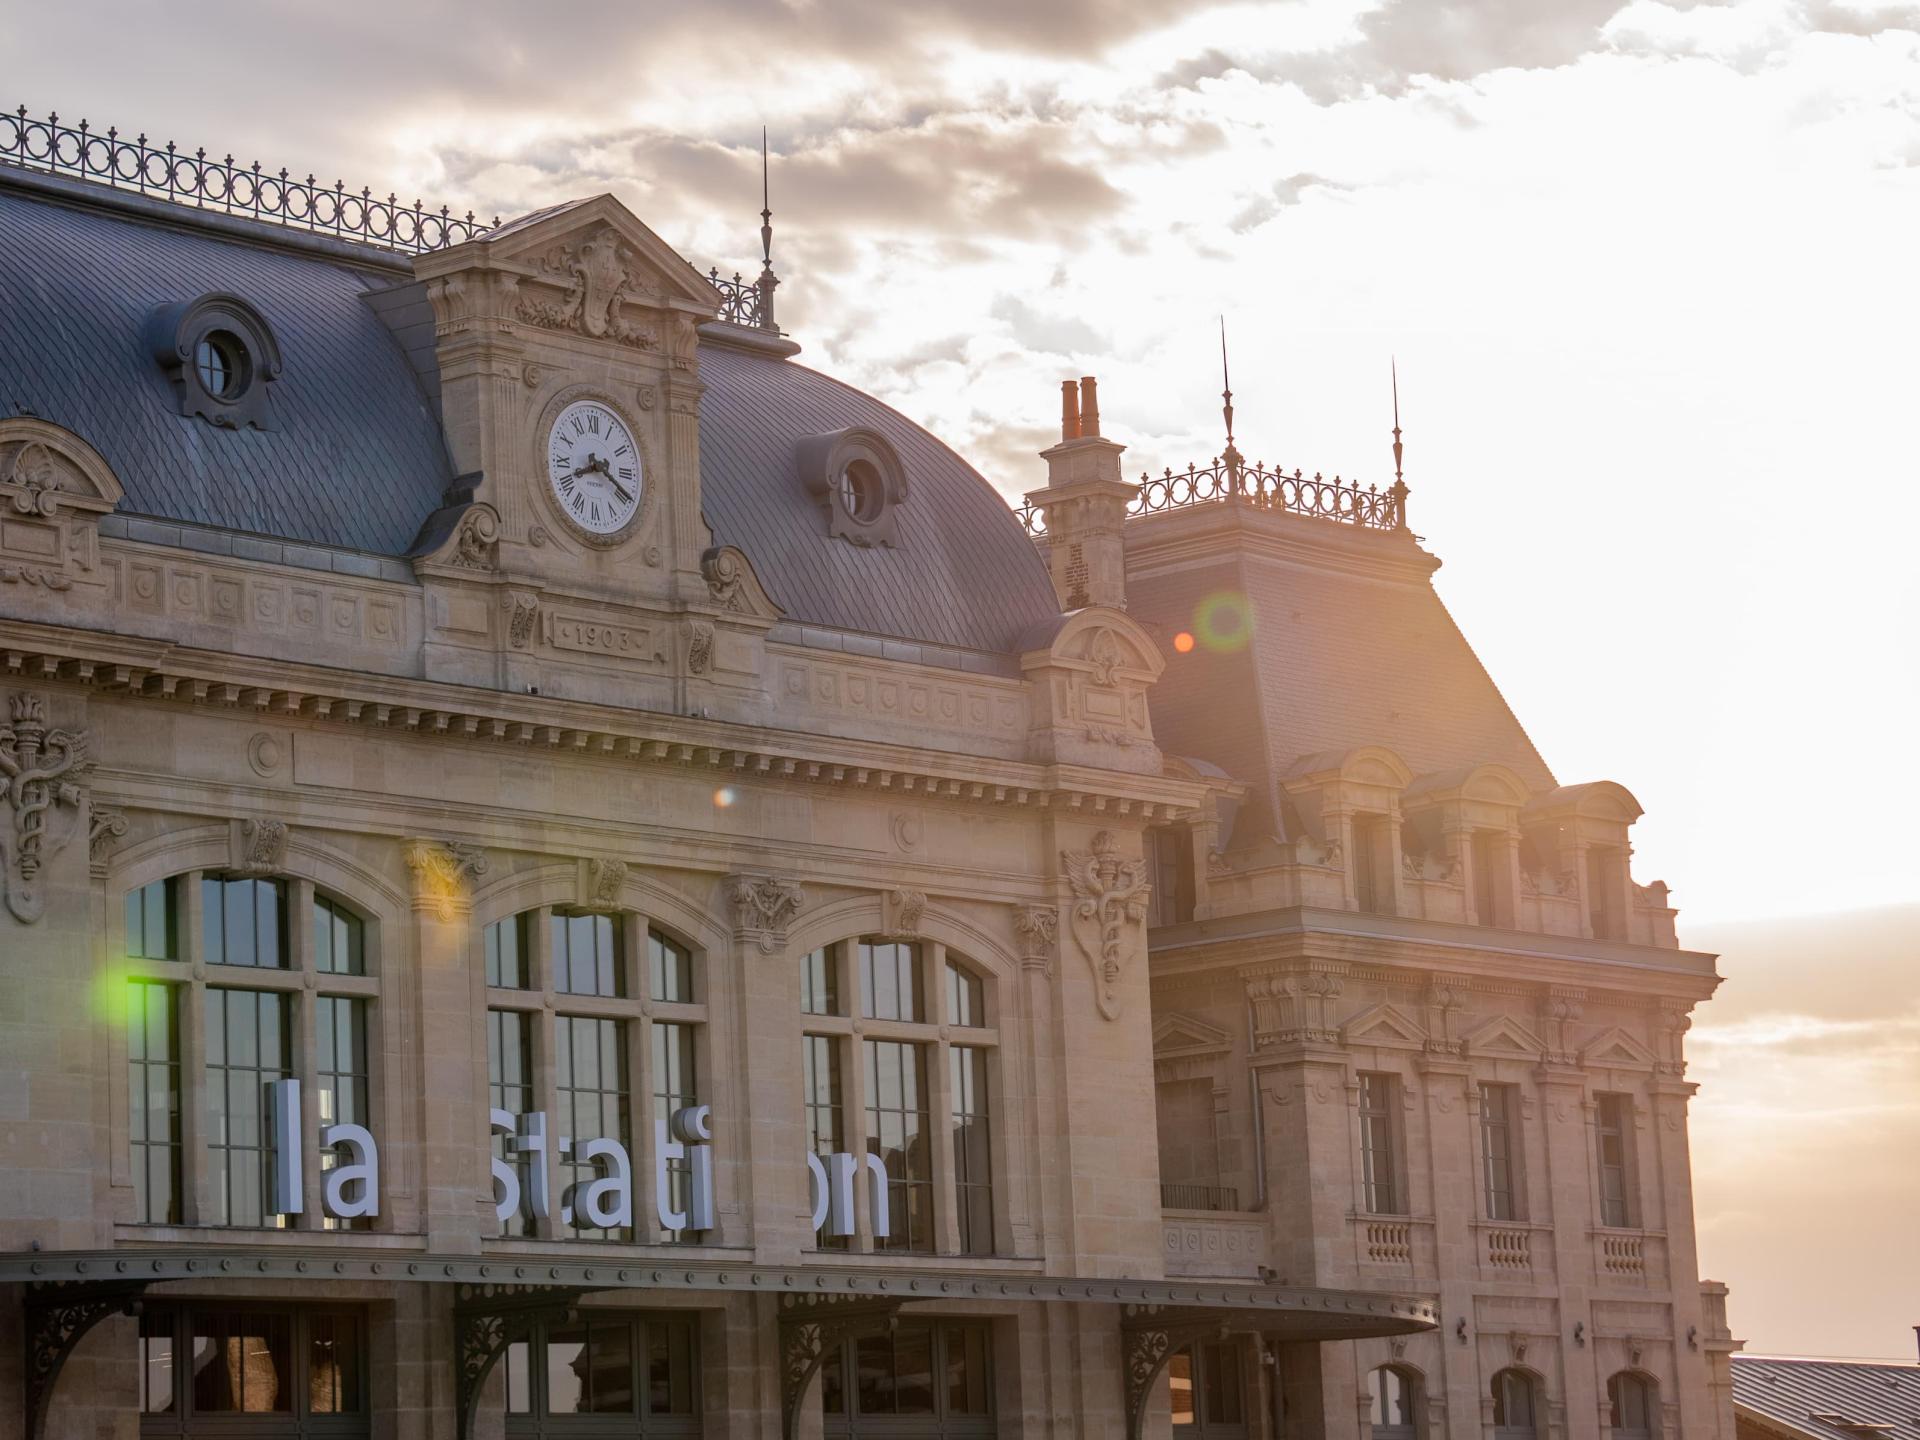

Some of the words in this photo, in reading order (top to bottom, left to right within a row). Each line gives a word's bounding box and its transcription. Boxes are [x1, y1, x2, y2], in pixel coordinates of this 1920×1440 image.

[570, 417, 585, 437] XI
[587, 415, 599, 434] XII
[559, 432, 574, 449] X
[614, 445, 627, 457] II
[556, 454, 571, 468] IX
[619, 467, 633, 480] III
[559, 474, 575, 497] VIII
[572, 491, 585, 514] VII
[591, 502, 600, 521] VI
[576, 625, 630, 650] 1903
[276, 1079, 379, 1218] la
[491, 1104, 890, 1237] Statin
